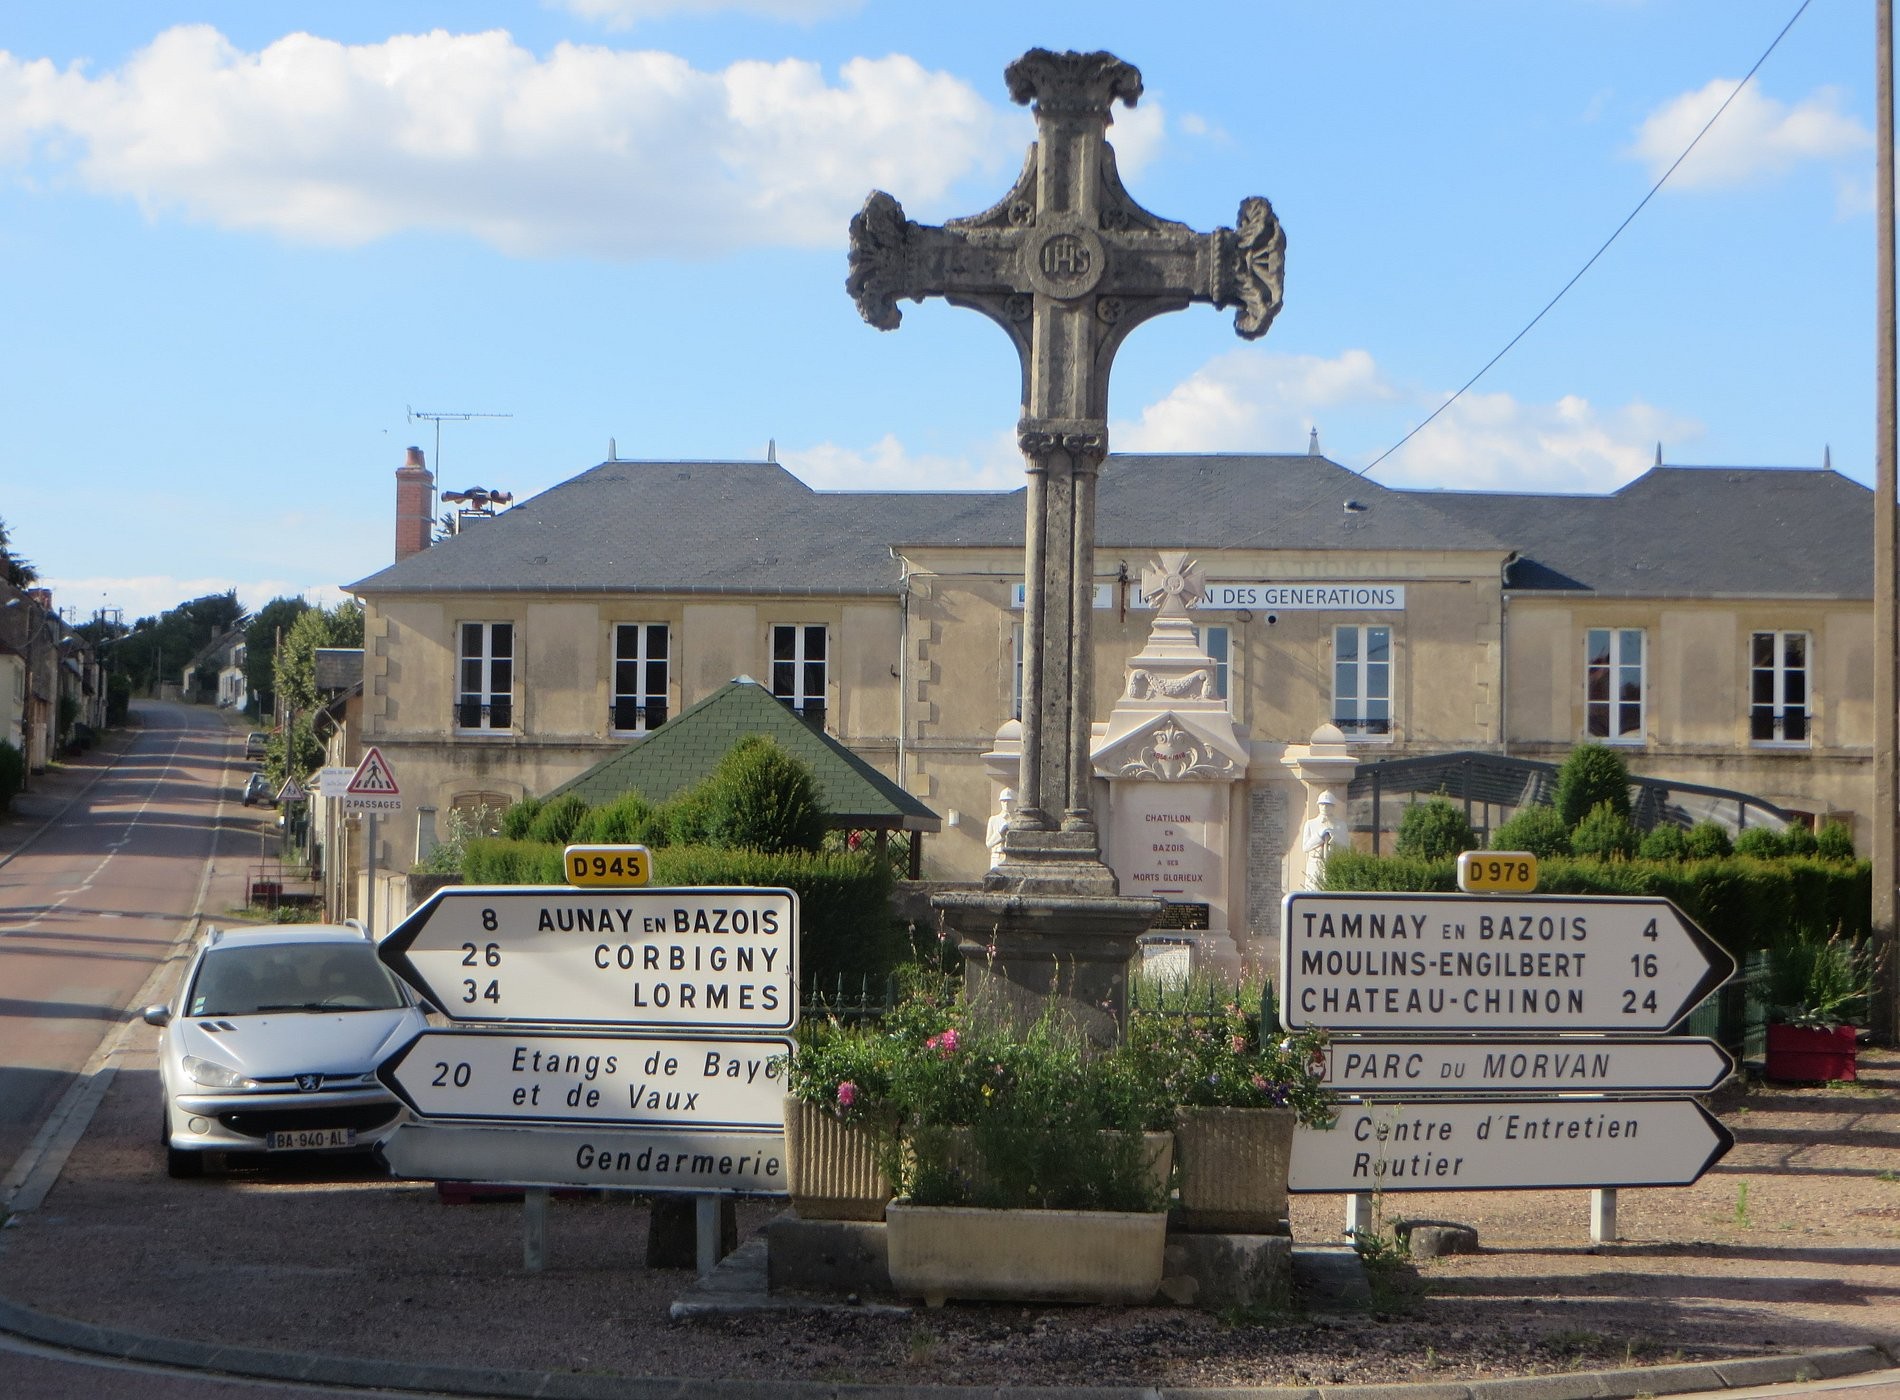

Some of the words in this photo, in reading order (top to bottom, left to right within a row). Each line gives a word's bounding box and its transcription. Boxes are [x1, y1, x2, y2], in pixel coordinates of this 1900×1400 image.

[1223, 589, 1257, 604] DES
[1265, 588, 1395, 605] GENERATIONS
[346, 800, 352, 808] 2
[354, 800, 401, 809] PASSAGES
[1145, 814, 1191, 823] CHATILLON
[1152, 843, 1185, 852] BAZOIS
[1132, 873, 1160, 882] MORTS
[1163, 873, 1203, 883] GLORIEUX
[481, 909, 498, 931] 8
[538, 908, 633, 933] AUNAY
[644, 917, 666, 933] EN
[673, 909, 779, 935] BAZOIS
[1303, 913, 1427, 940] TAMNAY
[1442, 924, 1465, 940] EN
[1479, 916, 1587, 941] BAZOIS
[1643, 918, 1658, 942] 4
[462, 942, 501, 967] 26
[594, 945, 778, 972] CORBIGNY
[1301, 950, 1586, 977] MOULINS-ENGILBERT
[1631, 954, 1658, 978] 16
[462, 979, 501, 1004] 34
[634, 982, 779, 1010] LORMES
[1301, 988, 1583, 1013] CHATEAU-CHINON
[1622, 990, 1657, 1014] 24
[432, 1062, 472, 1087] 20
[512, 1047, 618, 1081] Etangs
[644, 1051, 679, 1076] de
[1344, 1053, 1423, 1079] PARC
[1440, 1062, 1465, 1079] DU
[1483, 1054, 1610, 1079] MORVAN
[512, 1084, 541, 1106] et
[566, 1082, 600, 1107] de
[629, 1084, 700, 1111] Vaux
[1354, 1116, 1452, 1142] Centre
[576, 1143, 780, 1176] Gendarmerie
[1352, 1152, 1463, 1177] Routier
